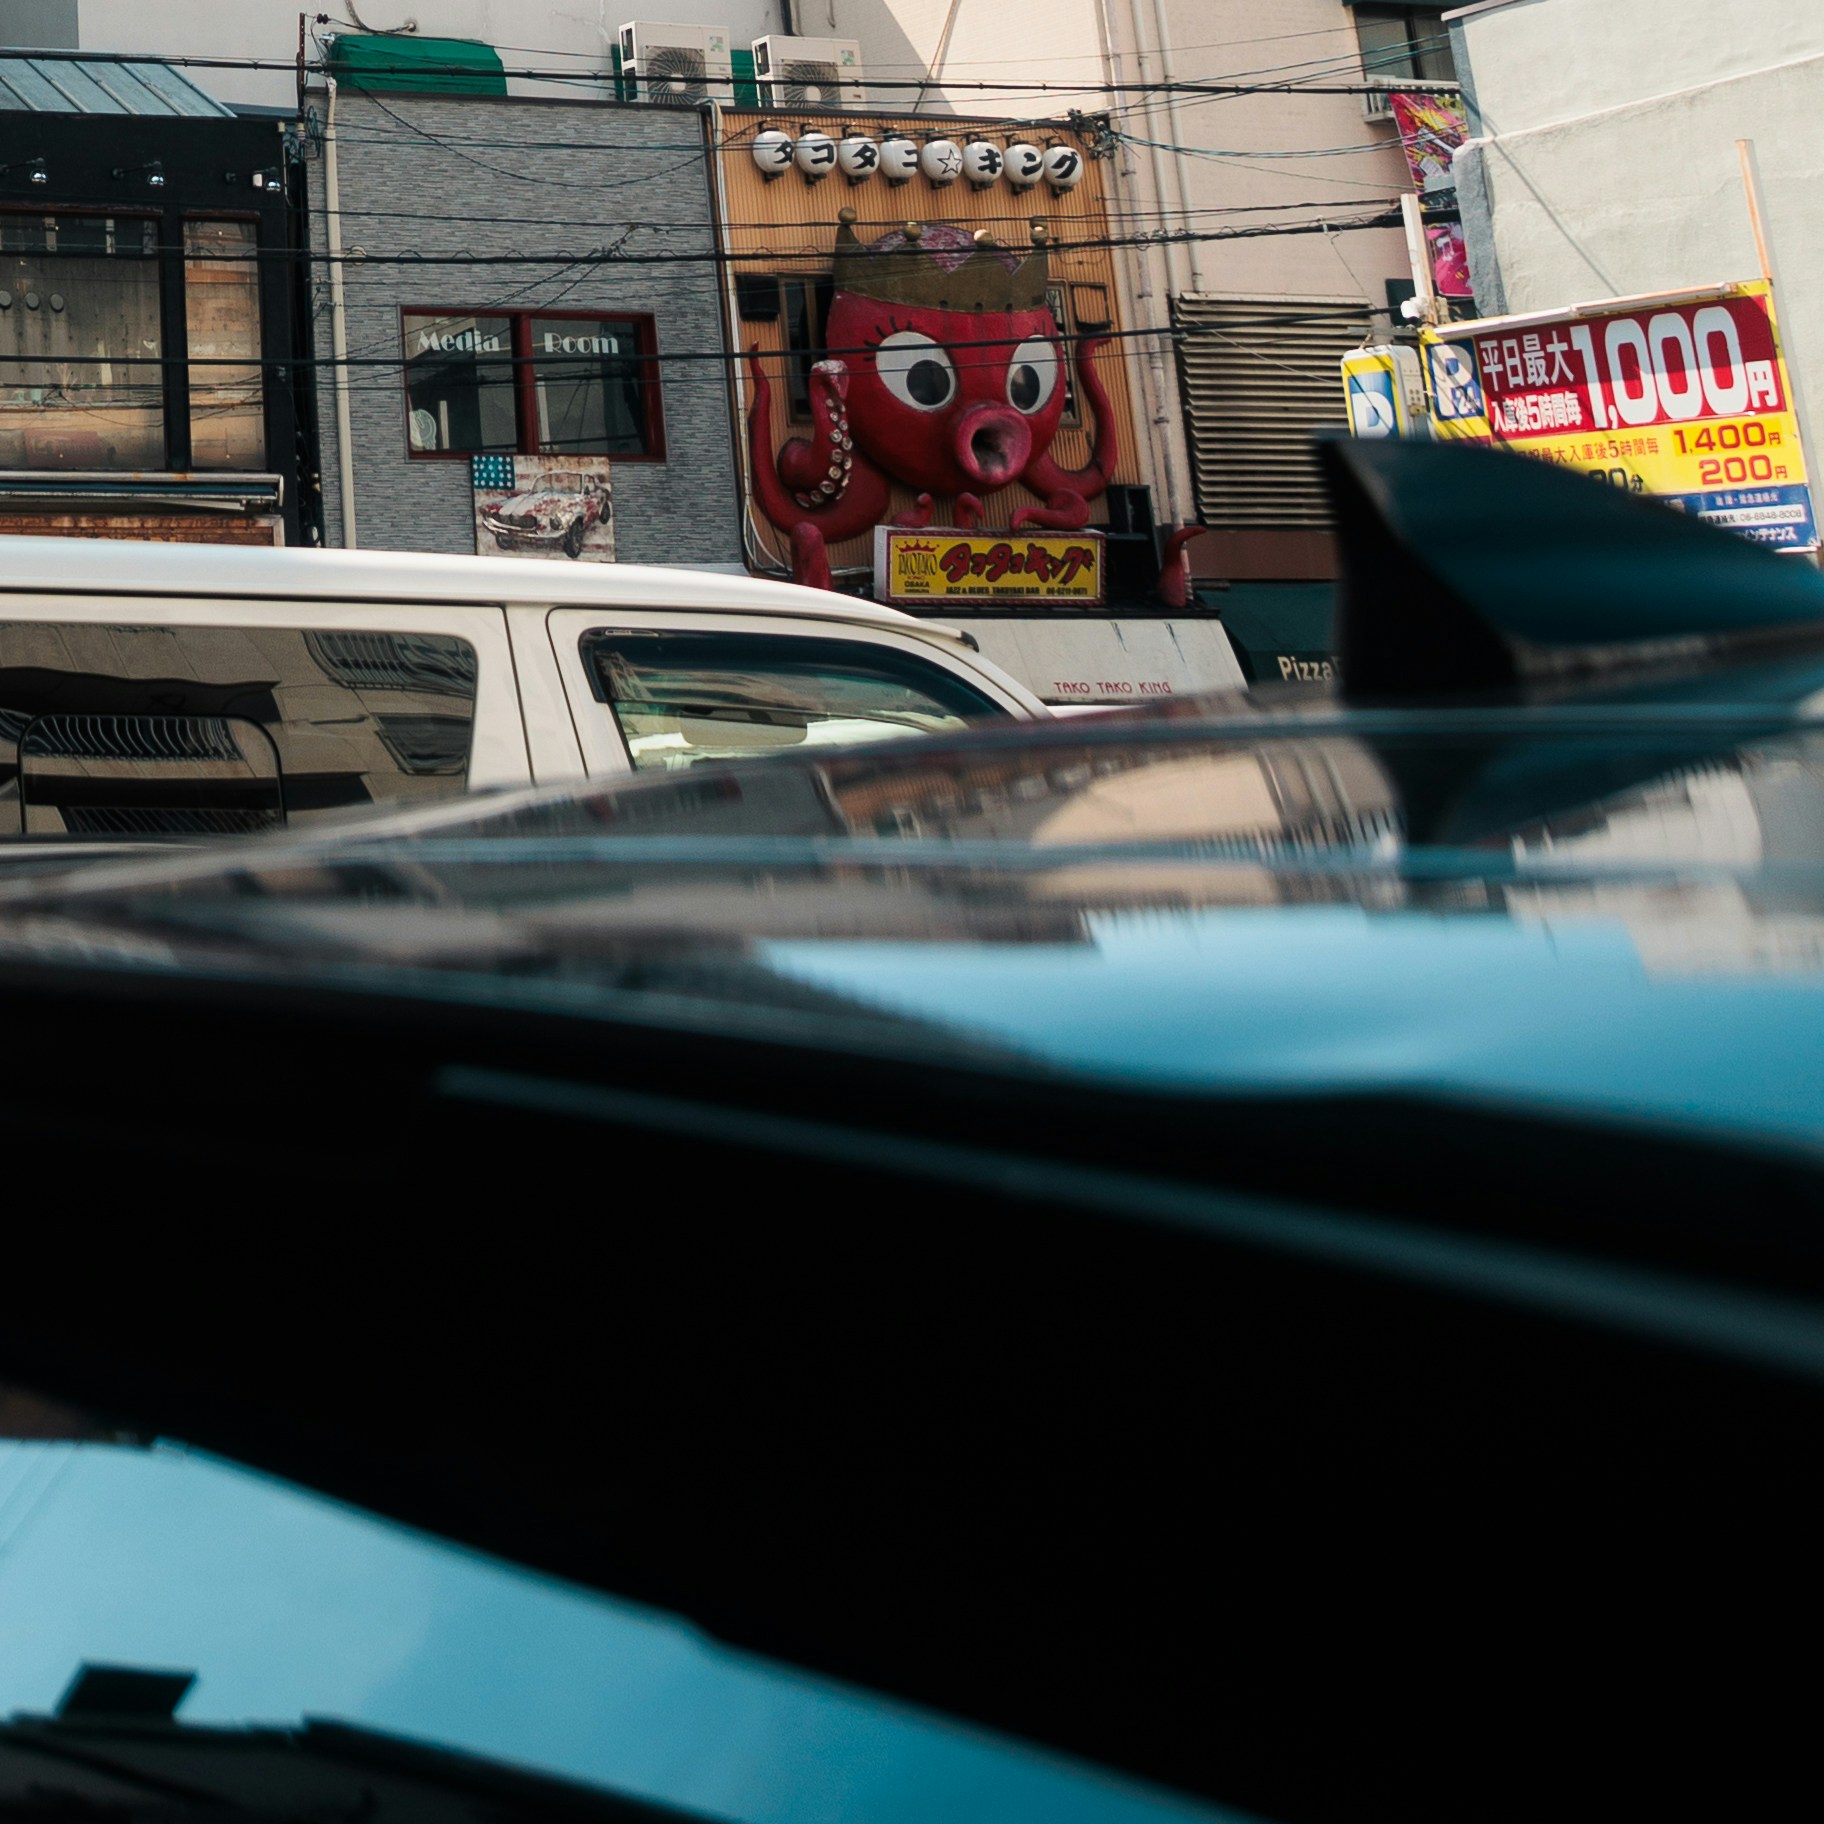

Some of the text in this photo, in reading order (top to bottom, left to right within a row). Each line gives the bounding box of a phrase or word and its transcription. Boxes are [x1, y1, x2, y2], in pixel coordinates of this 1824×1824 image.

[417, 329, 620, 354] Media Room
[1480, 331, 1574, 392] 平日最大
[1674, 422, 1781, 454] 1,400円
[1699, 455, 1787, 485] 200円
[1053, 681, 1173, 694] TAKO TAKO KING
